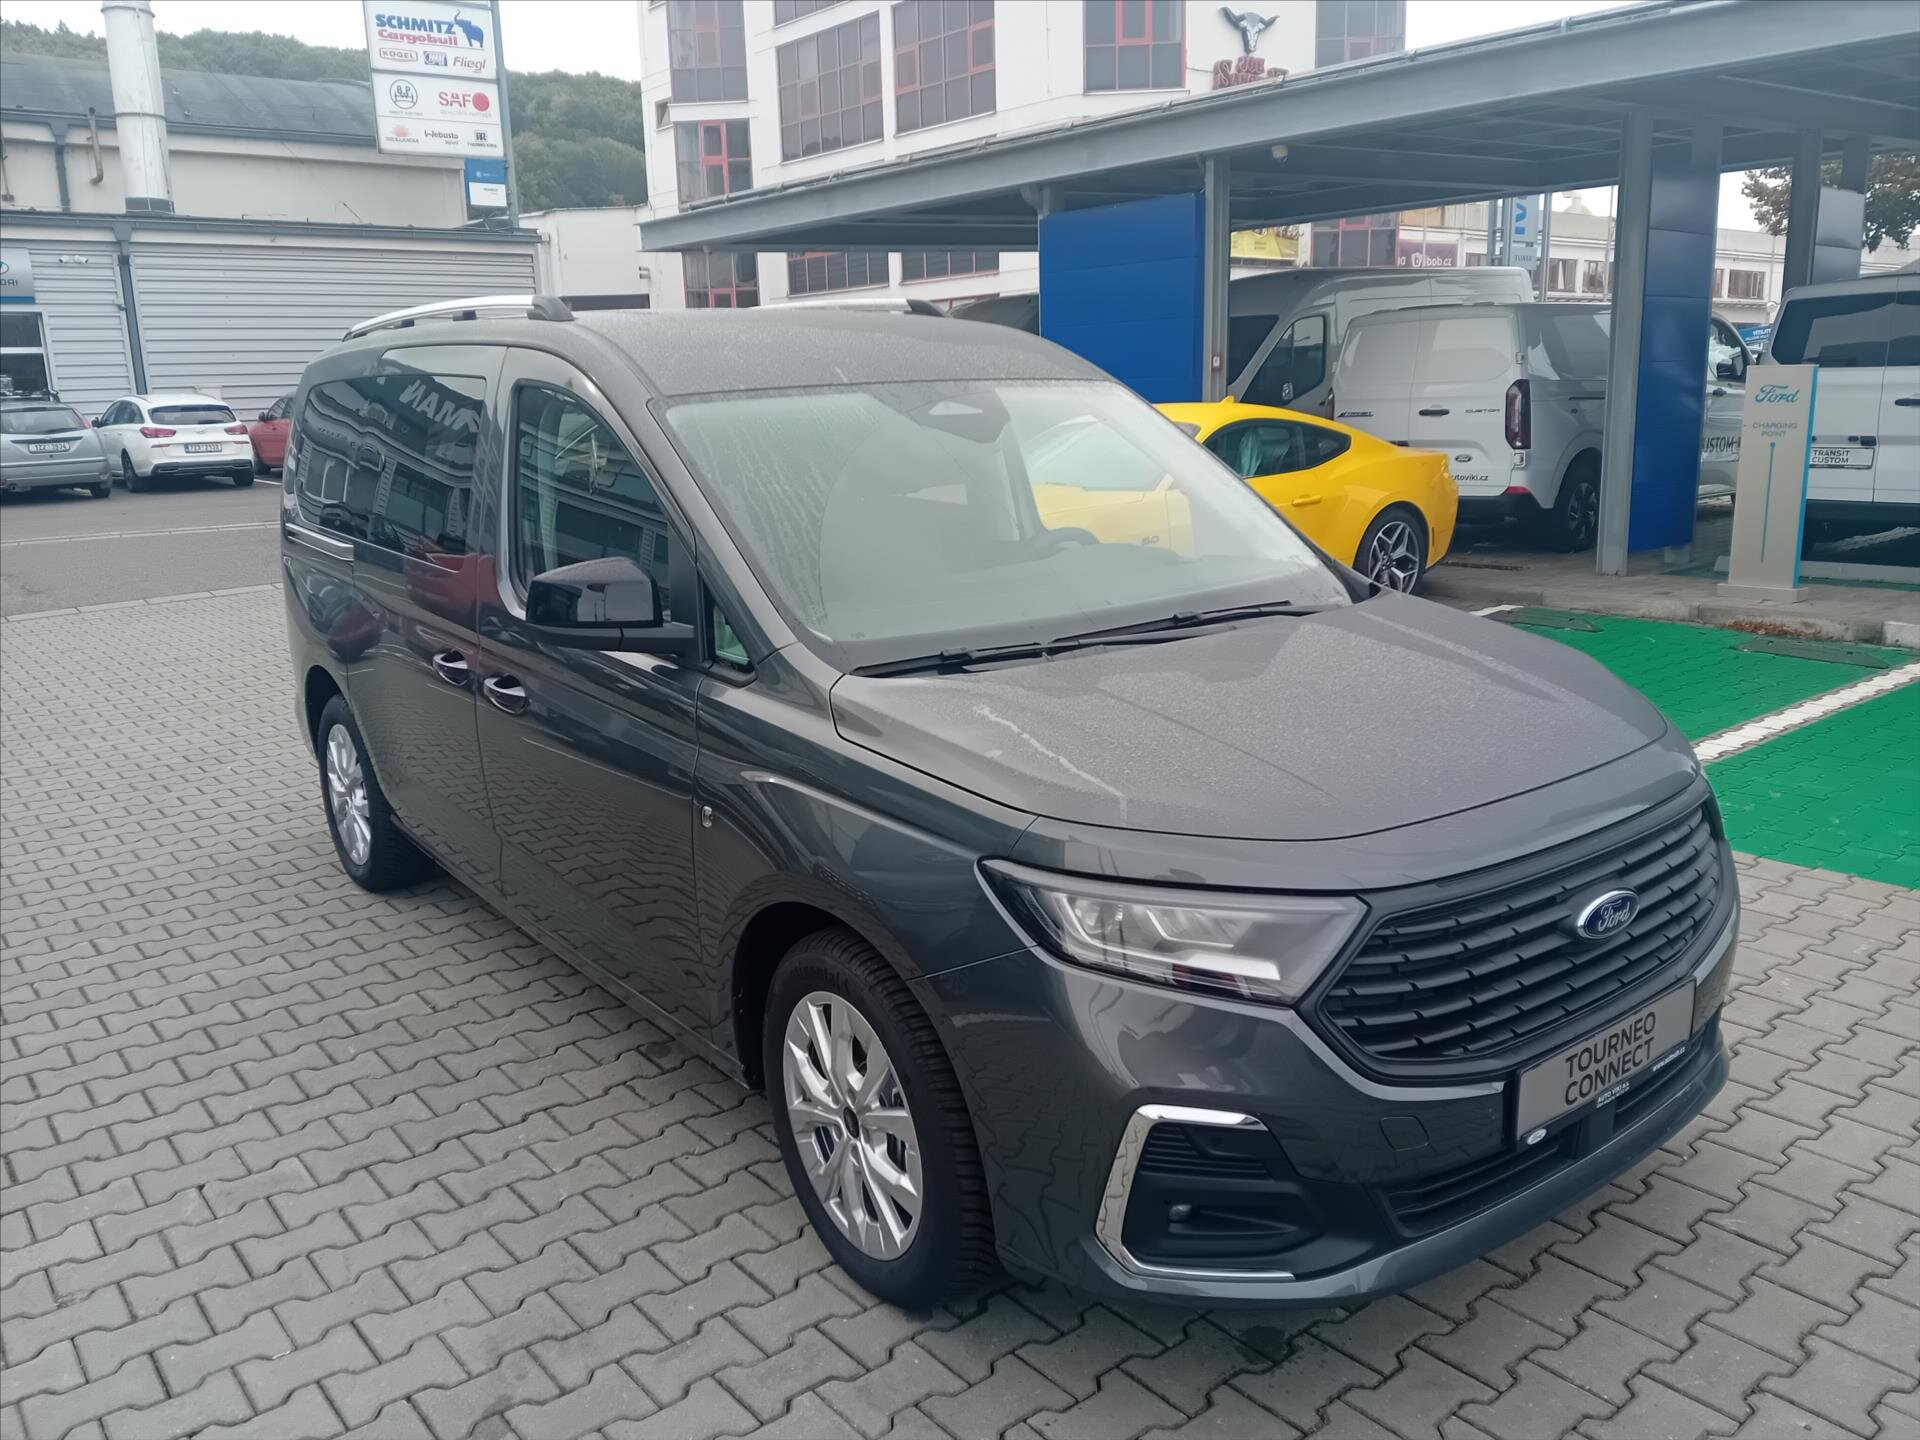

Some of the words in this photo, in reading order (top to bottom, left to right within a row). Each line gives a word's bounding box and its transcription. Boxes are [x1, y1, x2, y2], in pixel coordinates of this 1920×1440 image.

[375, 14, 456, 35] SCHMITZ
[377, 29, 458, 46] Cargobull
[453, 56, 486, 72] Fliegl
[438, 91, 472, 108] SAF
[1755, 384, 1800, 403] Ford
[1811, 456, 1849, 464] CUSTOM
[1598, 900, 1630, 932] Ford
[1565, 1011, 1656, 1078] TOURNEO
[1565, 1036, 1655, 1106] CONNECT
[1597, 1090, 1612, 1103] AUTO
